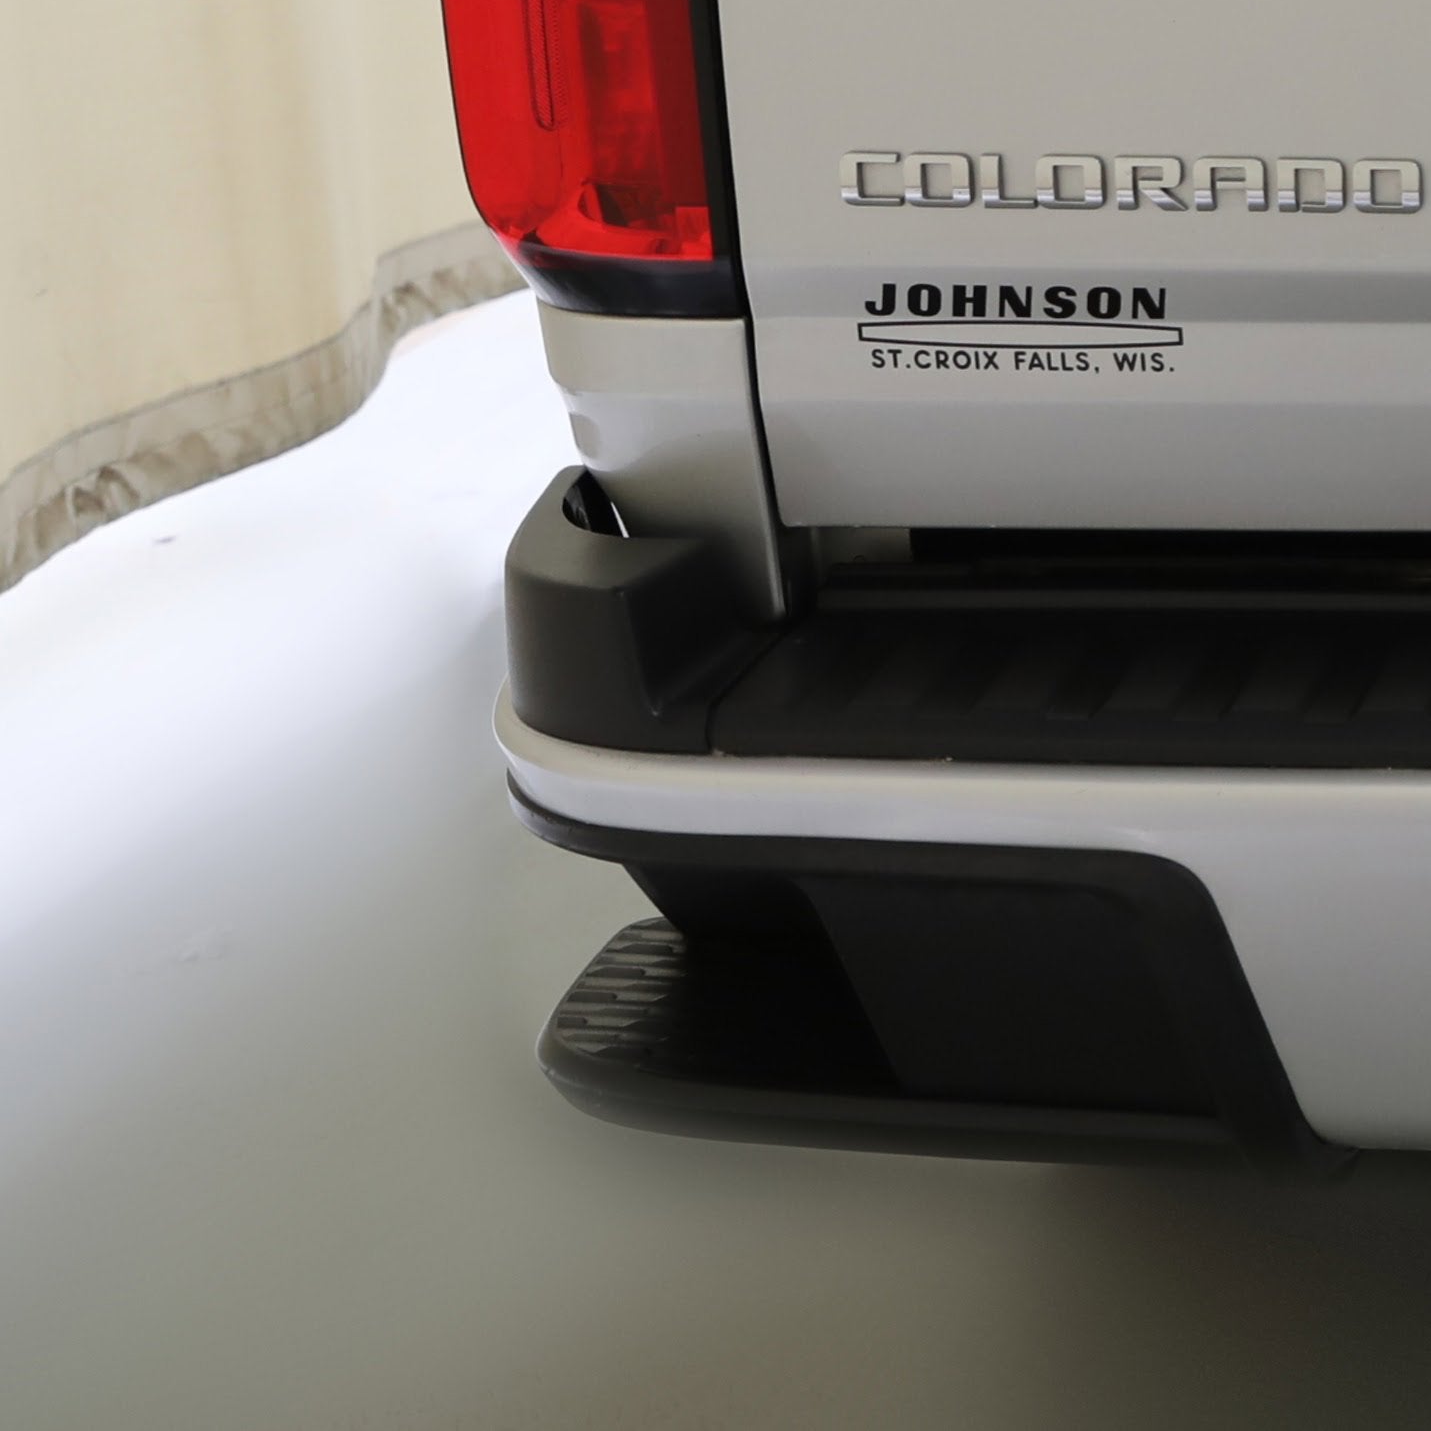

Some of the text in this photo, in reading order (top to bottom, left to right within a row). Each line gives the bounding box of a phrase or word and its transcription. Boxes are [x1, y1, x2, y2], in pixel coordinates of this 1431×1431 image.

[839, 150, 1424, 215] COLORADO
[864, 283, 1168, 320] JOHNSON
[1013, 351, 1101, 373] FALLS,
[1113, 352, 1175, 372] WIS.
